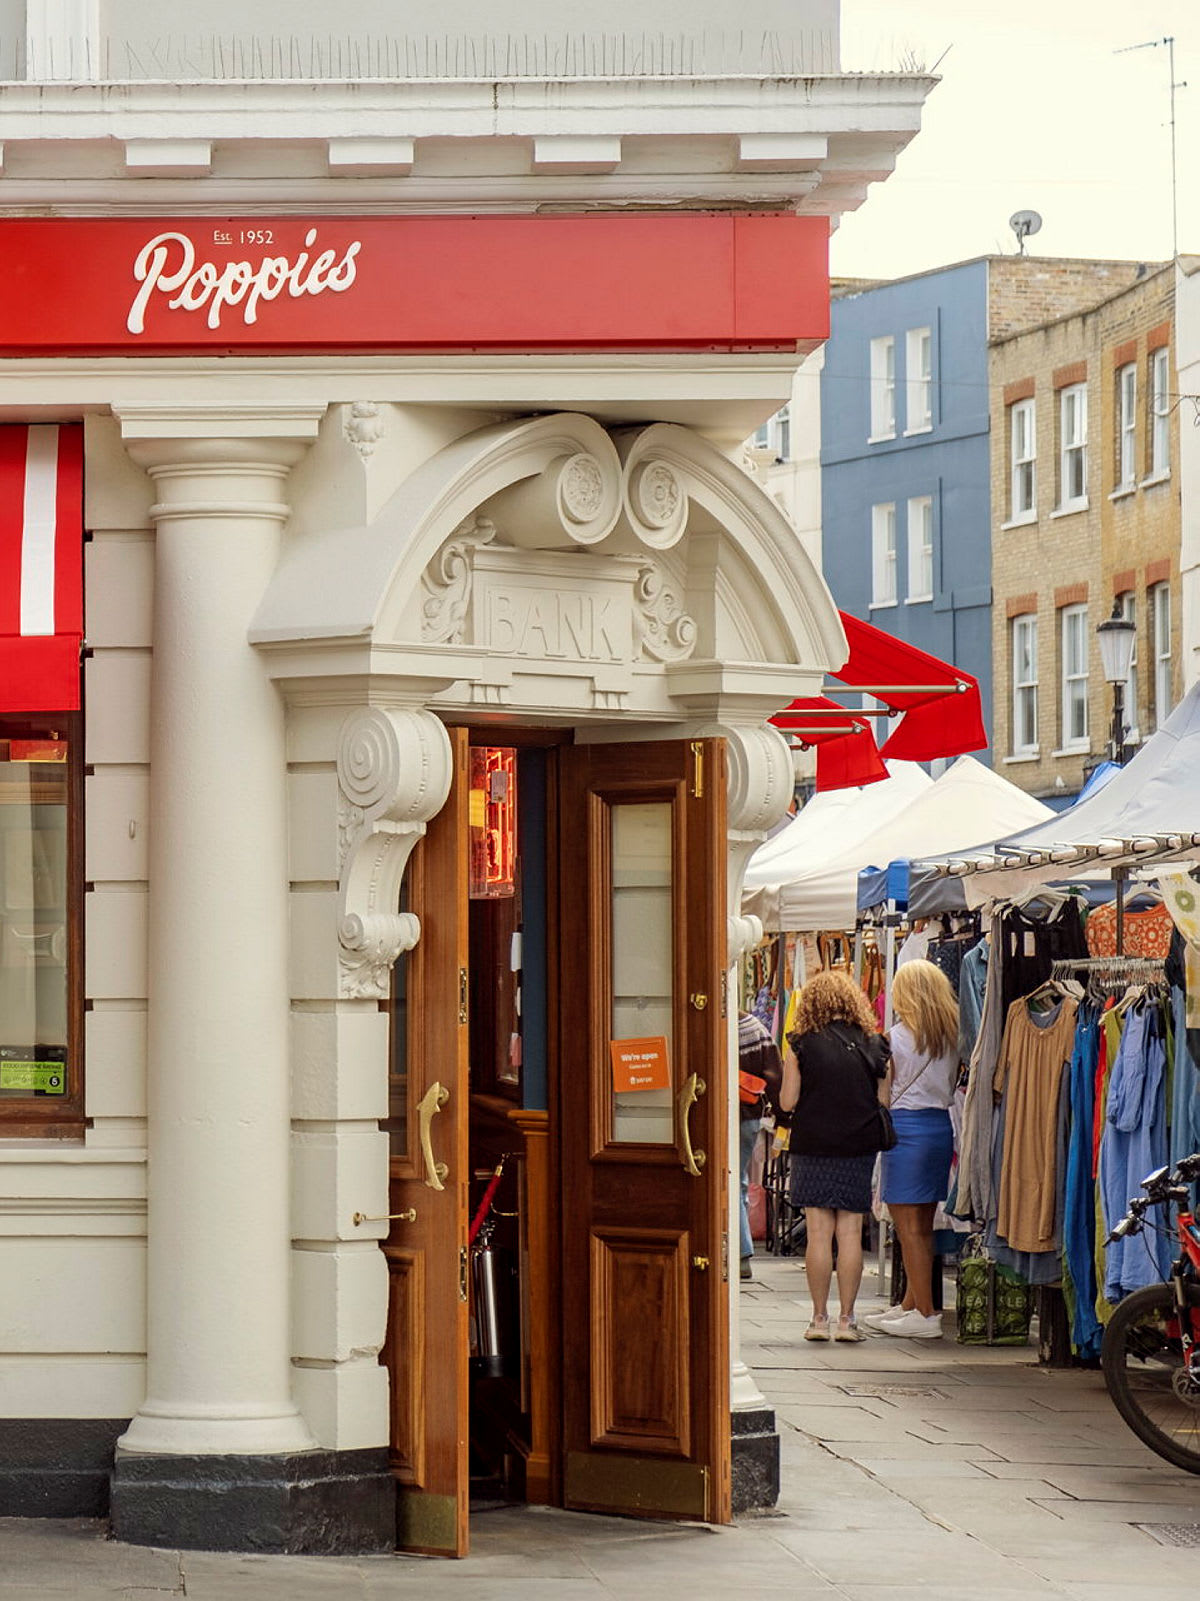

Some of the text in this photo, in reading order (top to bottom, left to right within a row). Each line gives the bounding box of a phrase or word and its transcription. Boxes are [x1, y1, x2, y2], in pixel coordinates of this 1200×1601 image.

[213, 230, 274, 244] Est. 1952
[126, 228, 362, 334] Poppies
[487, 590, 622, 660] BANK
[620, 1052, 658, 1061] We're open
